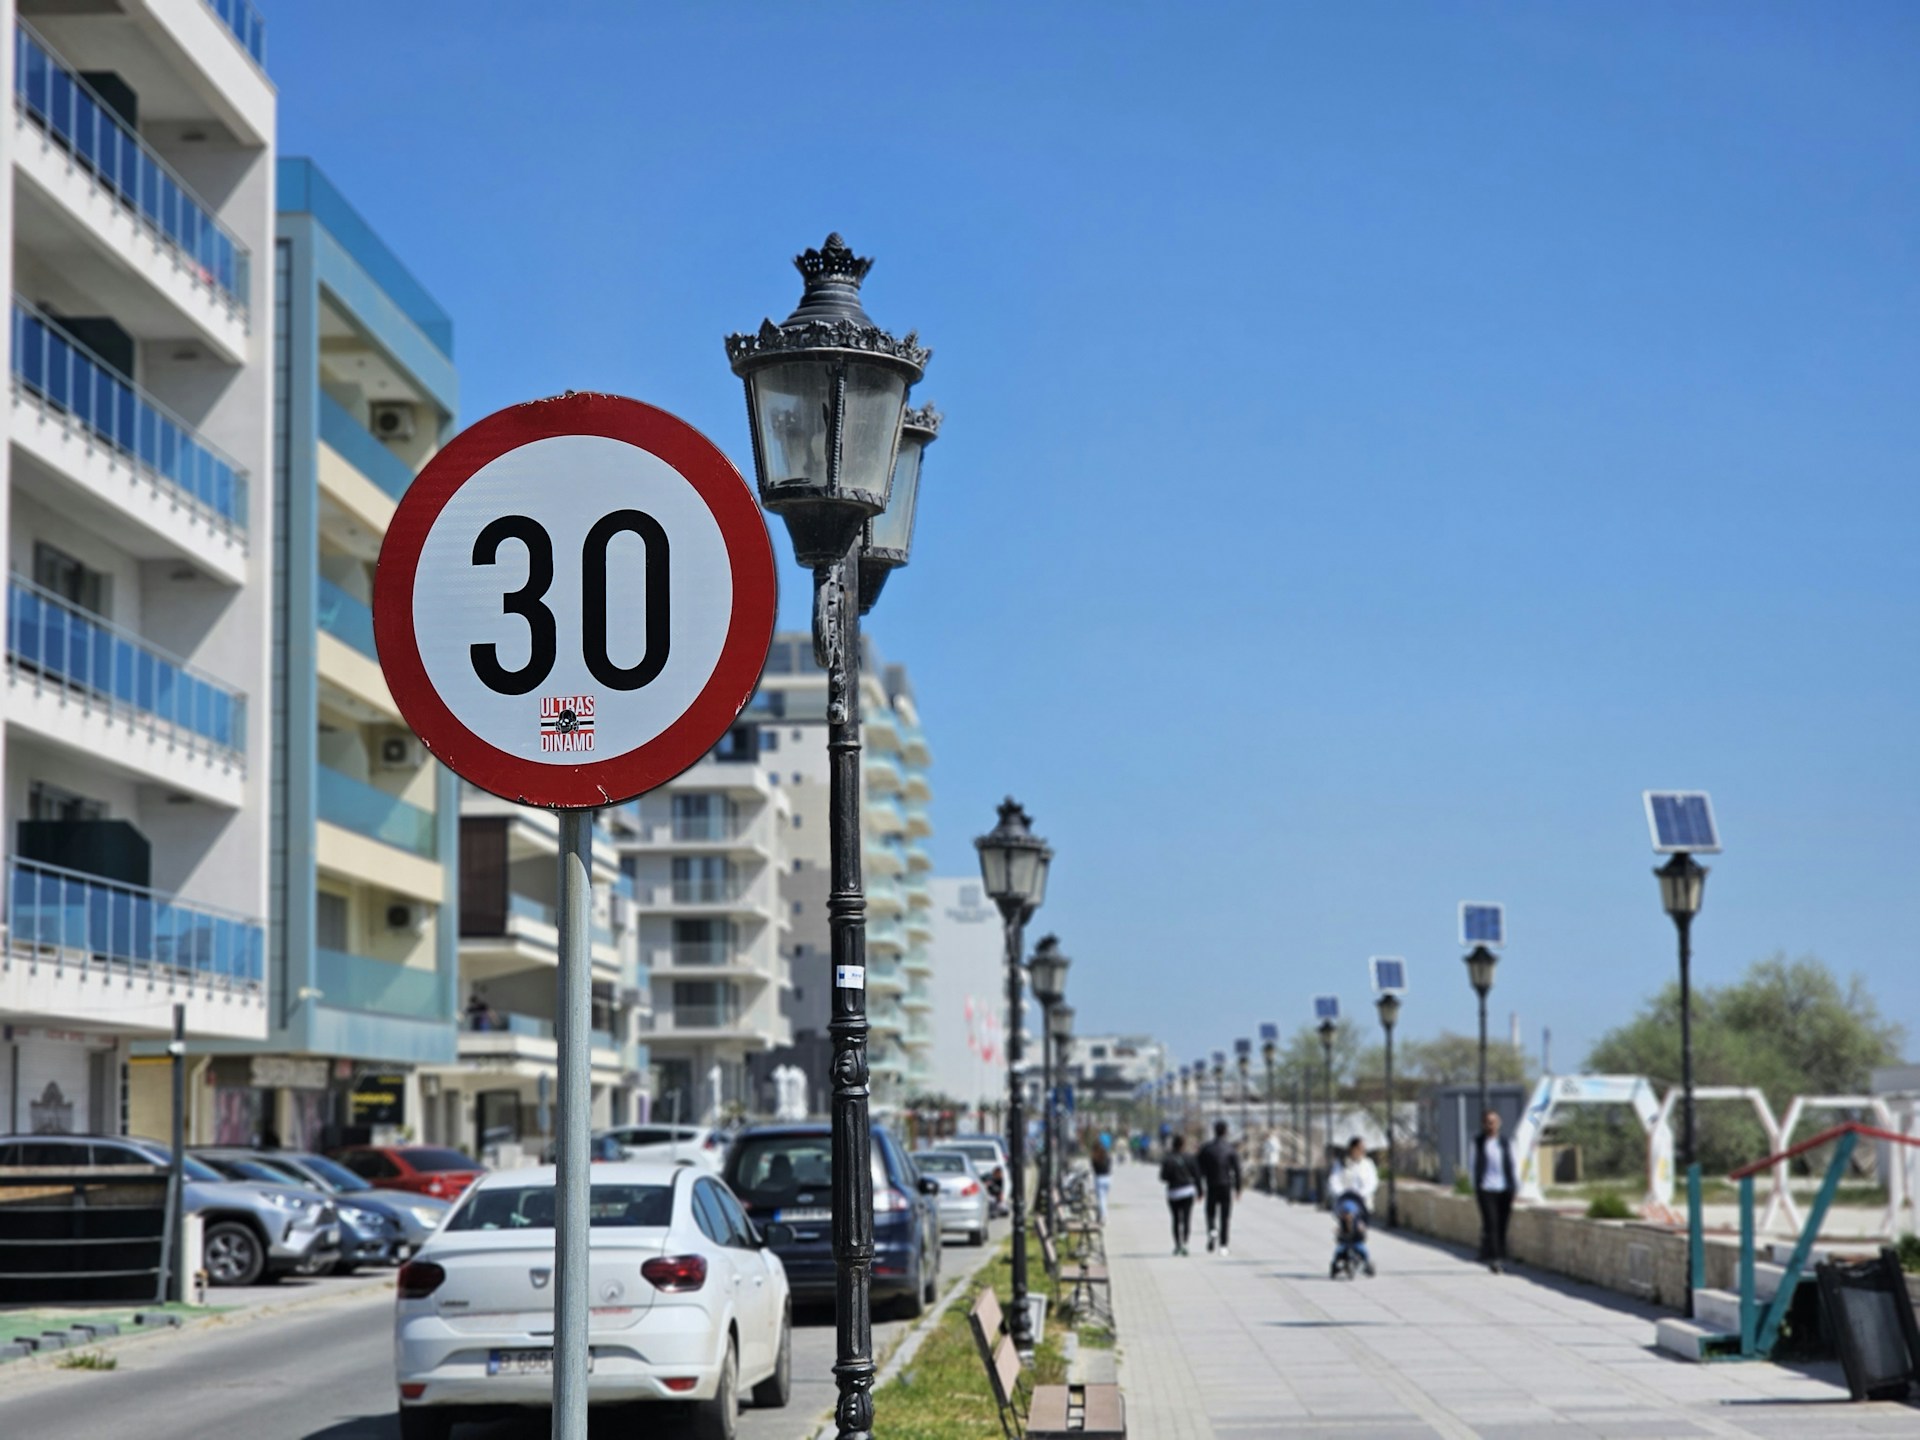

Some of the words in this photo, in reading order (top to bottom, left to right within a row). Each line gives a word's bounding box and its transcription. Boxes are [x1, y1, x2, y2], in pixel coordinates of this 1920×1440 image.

[470, 509, 671, 696] 30
[541, 696, 594, 716] ULTRAS
[541, 733, 595, 752] DINAMO
